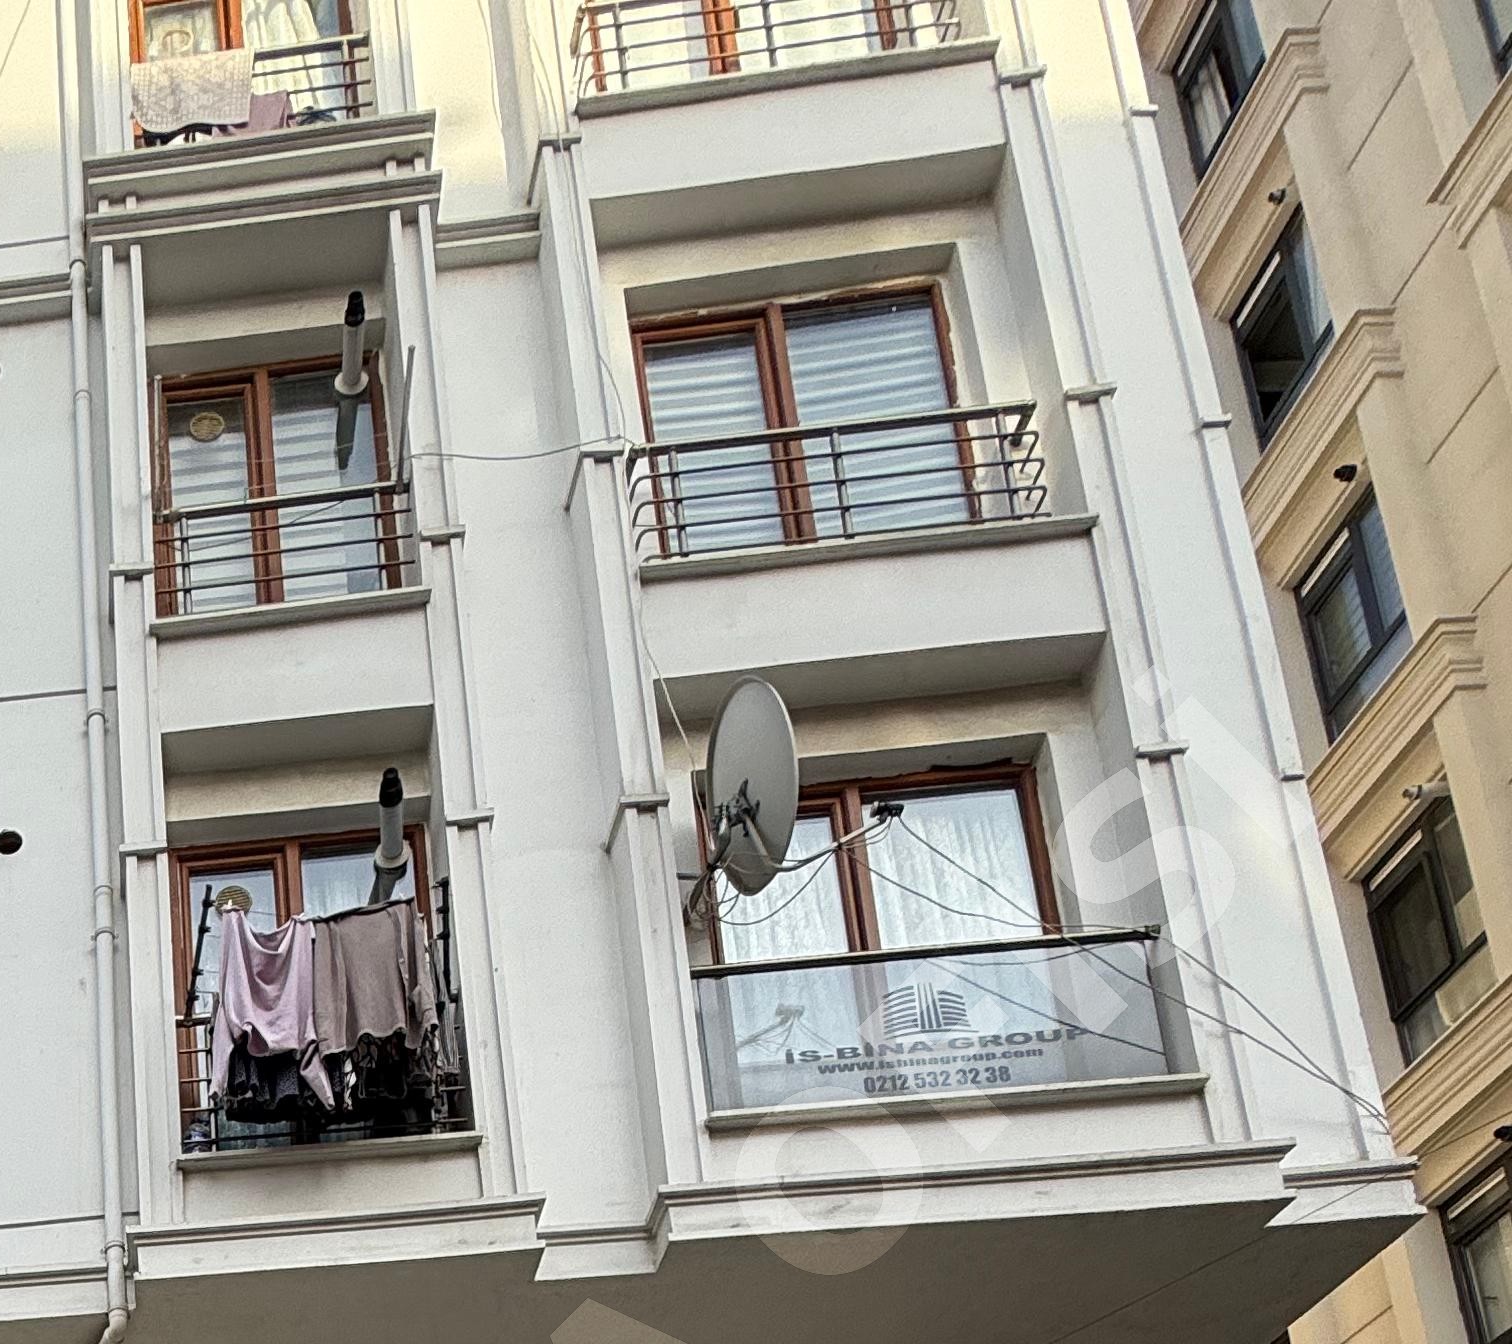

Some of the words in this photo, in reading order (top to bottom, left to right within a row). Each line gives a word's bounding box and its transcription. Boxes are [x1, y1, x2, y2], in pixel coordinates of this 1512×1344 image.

[947, 1027, 1089, 1050] GROUP
[863, 1074, 910, 1093] 0212
[913, 1070, 952, 1089] 532
[955, 1067, 981, 1086] 32
[984, 1065, 1012, 1083] 38
